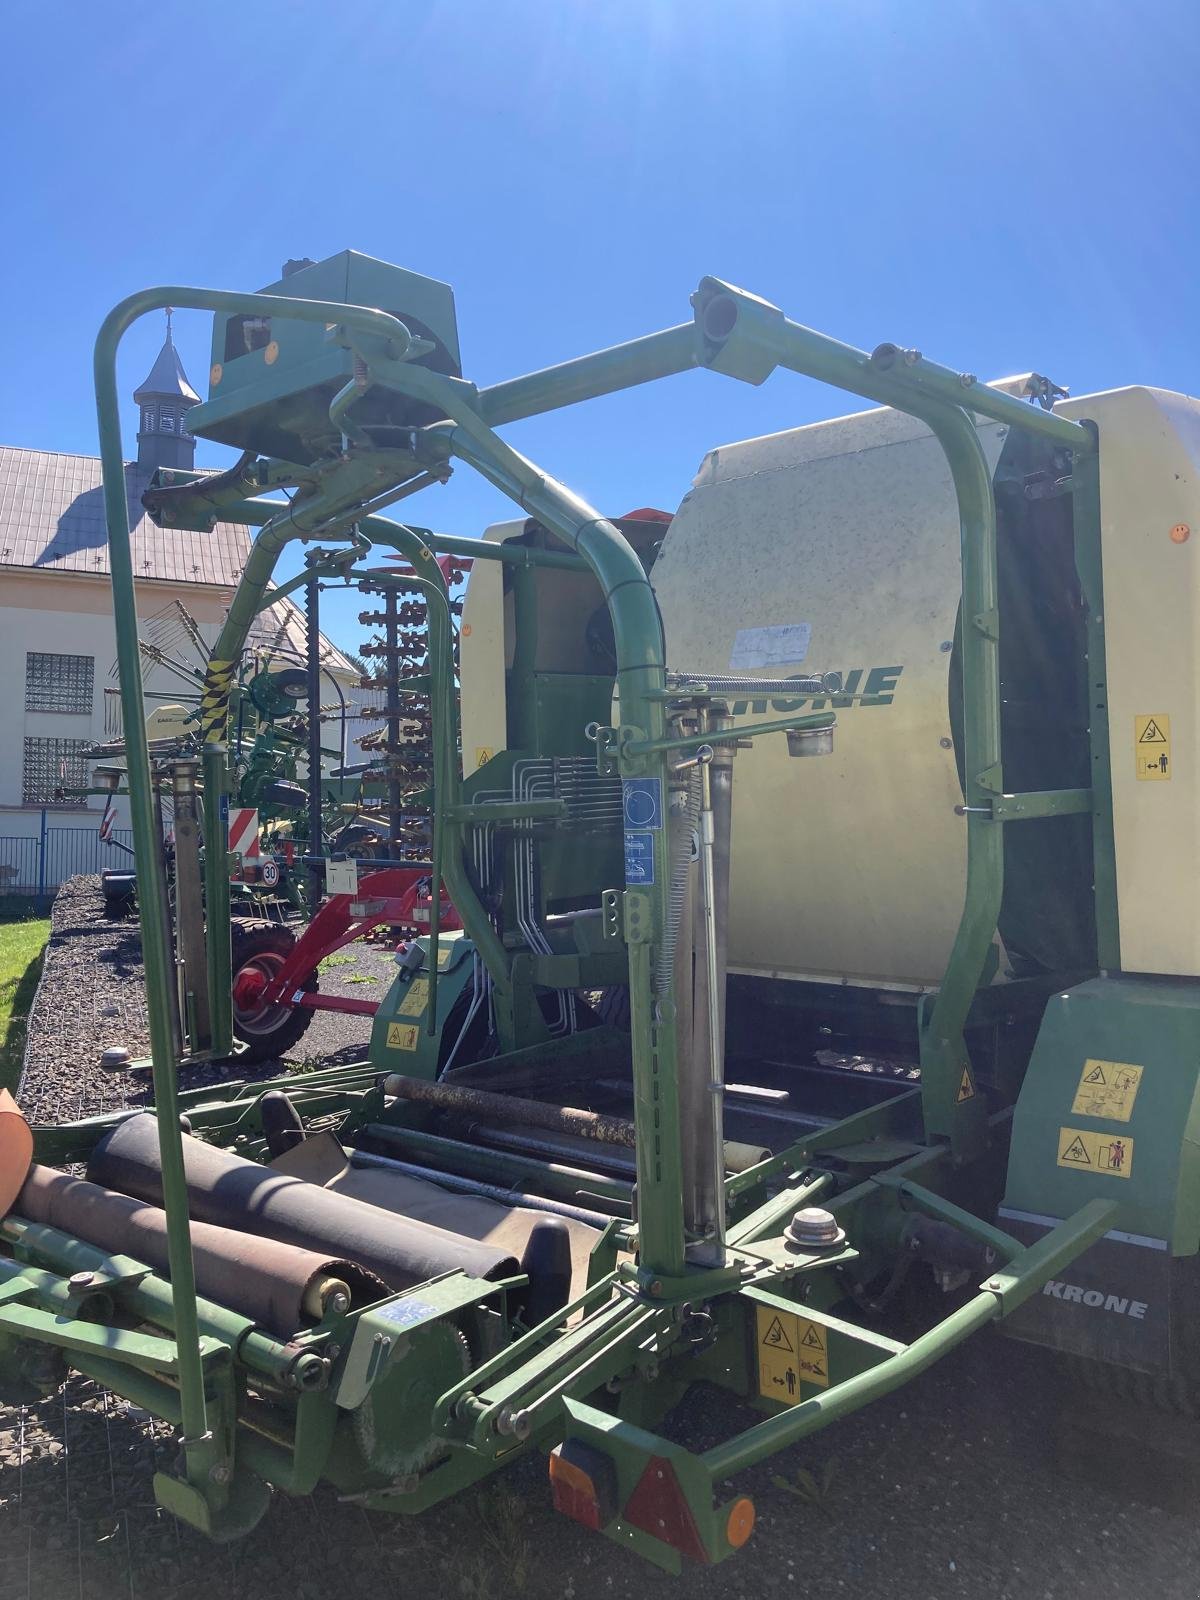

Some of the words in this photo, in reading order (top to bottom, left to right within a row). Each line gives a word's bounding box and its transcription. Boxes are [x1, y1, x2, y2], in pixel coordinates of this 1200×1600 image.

[731, 665, 904, 715] ONE
[265, 866, 275, 879] 30
[1043, 1280, 1148, 1319] KRONE
